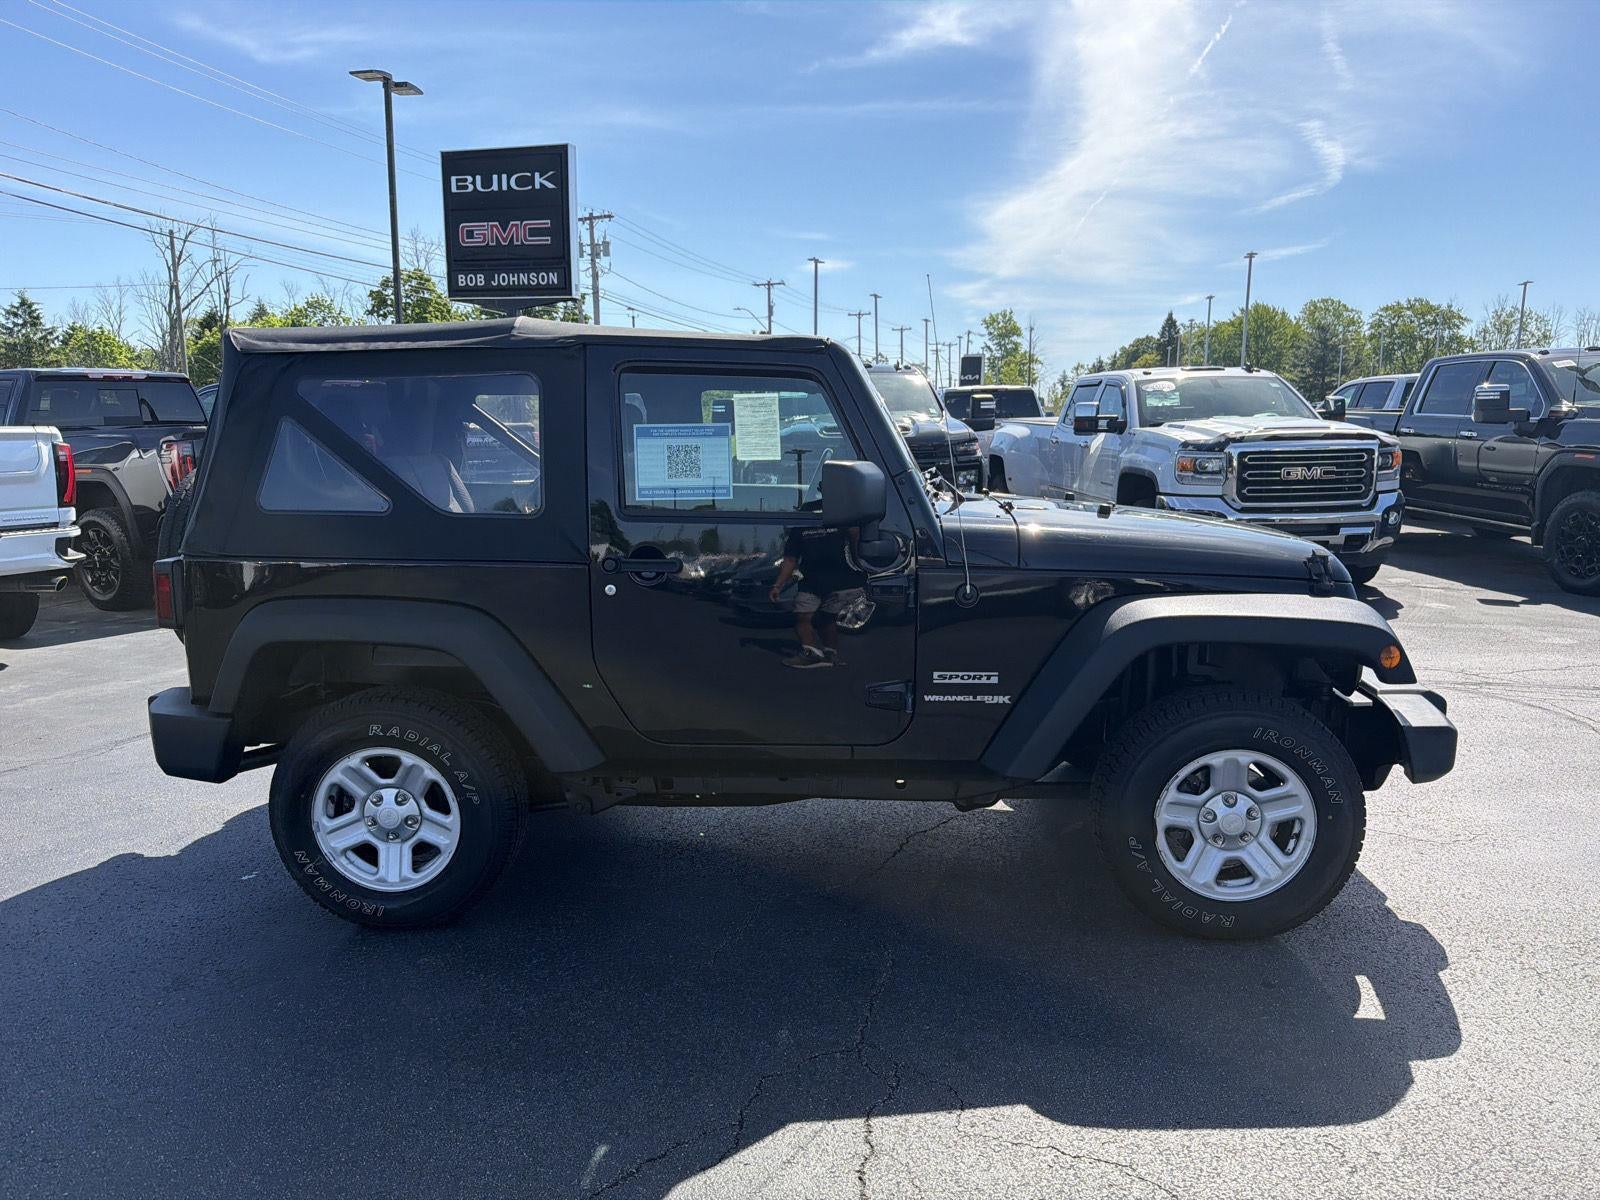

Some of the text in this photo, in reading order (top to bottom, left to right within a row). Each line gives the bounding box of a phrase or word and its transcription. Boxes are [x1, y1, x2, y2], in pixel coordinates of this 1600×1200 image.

[450, 171, 558, 193] BUICK
[458, 219, 551, 247] GMC
[458, 272, 558, 287] BOB JOHNSON
[1281, 466, 1336, 480] GMC
[936, 673, 998, 682] SPORT
[368, 724, 481, 805] RADIAL A/P
[1252, 727, 1344, 805] IRONMAN
[294, 850, 385, 917] IRONMAN
[1128, 835, 1236, 929] RADIAL A/P
